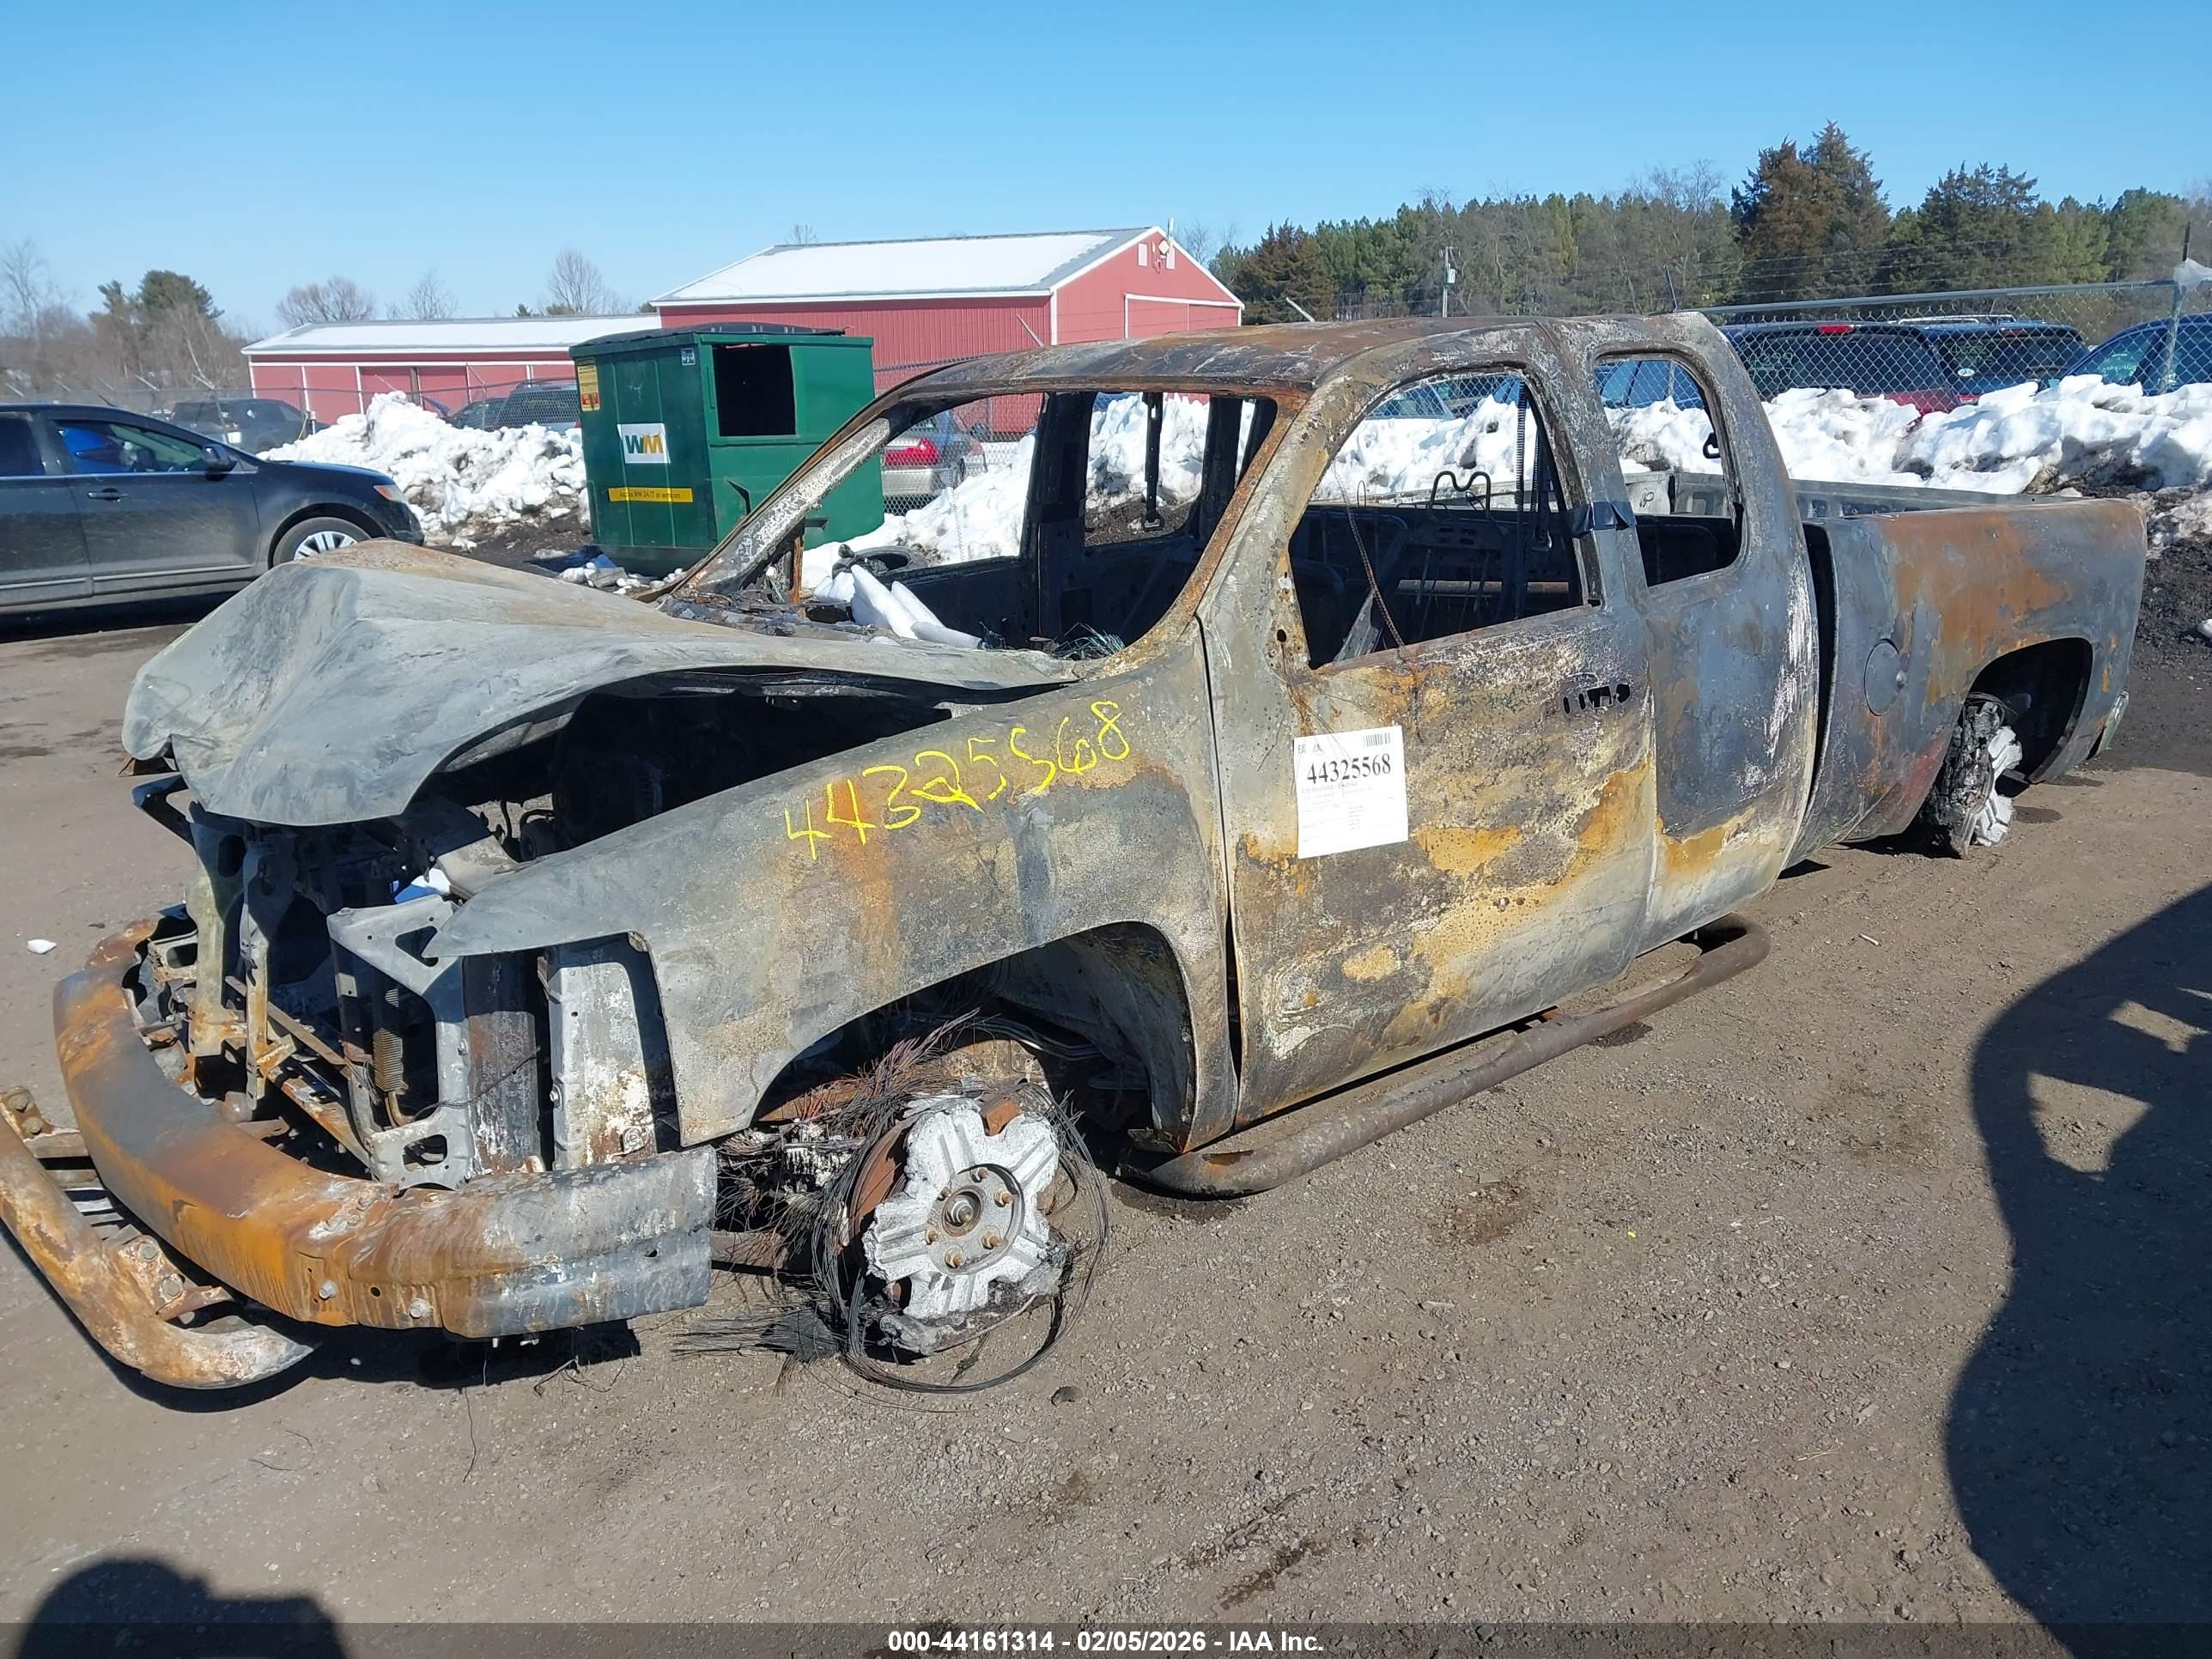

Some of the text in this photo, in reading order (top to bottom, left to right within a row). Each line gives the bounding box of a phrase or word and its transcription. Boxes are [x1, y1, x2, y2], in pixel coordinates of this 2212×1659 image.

[624, 434, 664, 454] WM
[785, 701, 1131, 860] 44325568
[1307, 753, 1391, 784] 44325568
